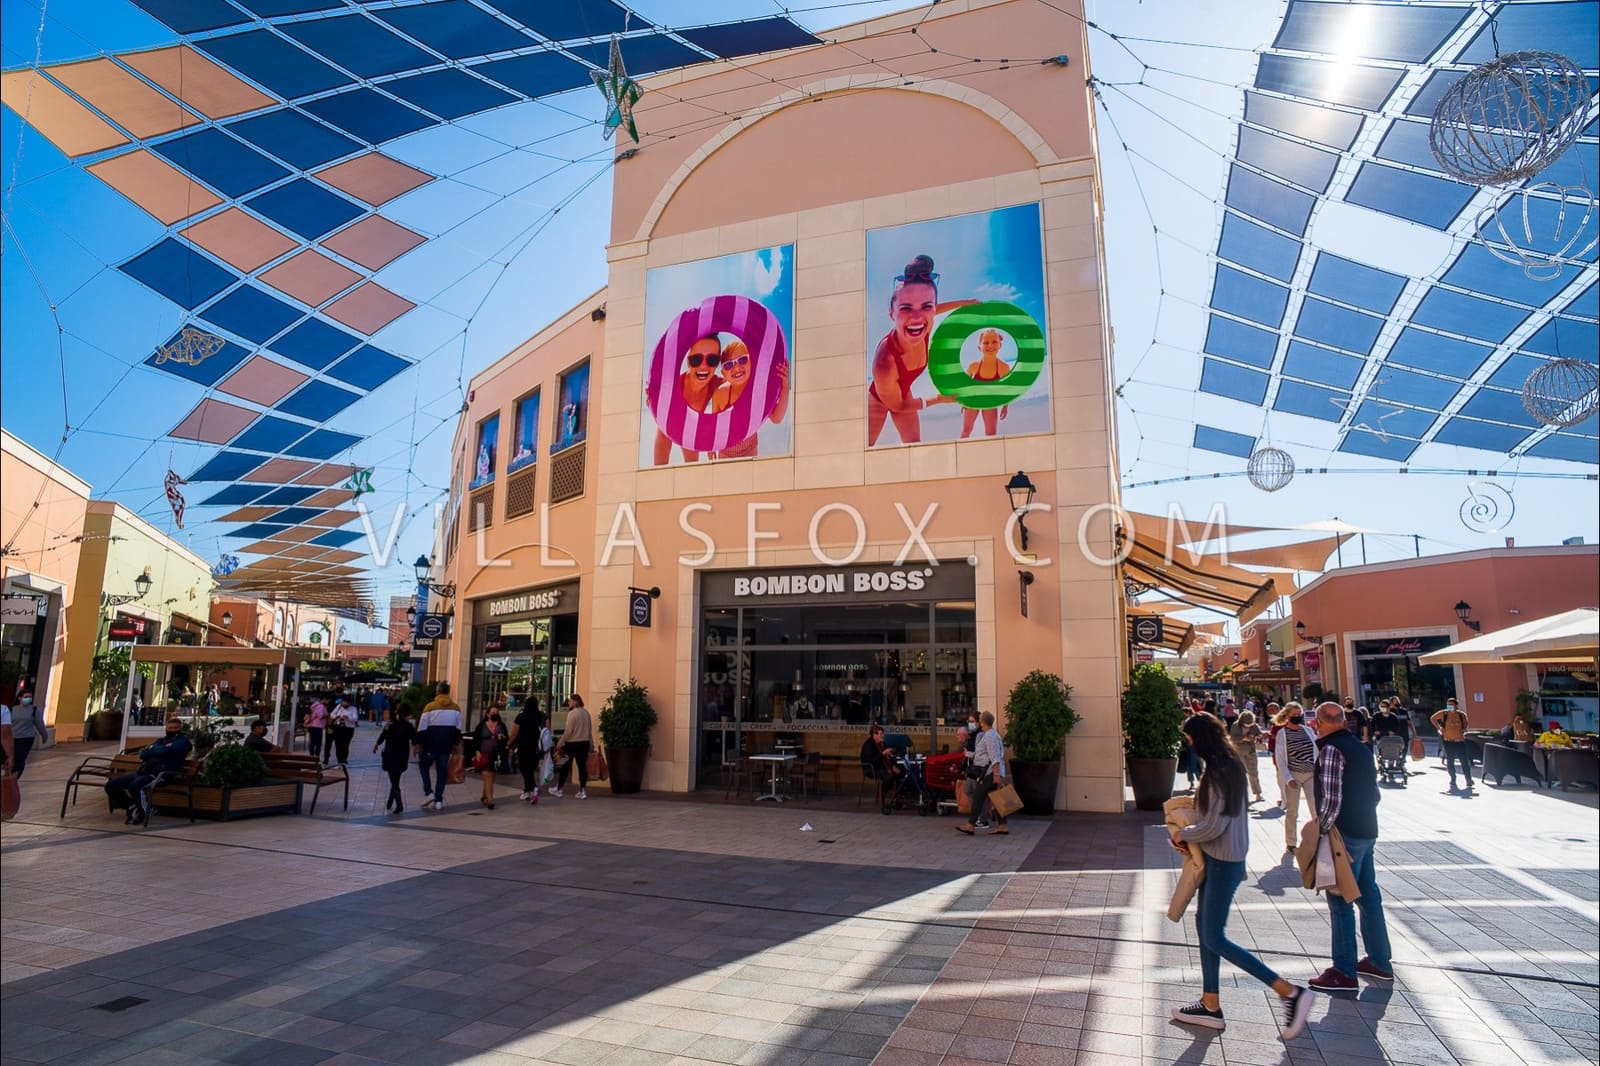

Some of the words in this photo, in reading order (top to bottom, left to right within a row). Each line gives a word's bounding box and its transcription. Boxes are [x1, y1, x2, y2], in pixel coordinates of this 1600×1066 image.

[734, 574, 845, 596] BOMBON
[853, 569, 926, 592] BOSS
[490, 596, 527, 616] BOMBON
[529, 592, 555, 609] BOSS
